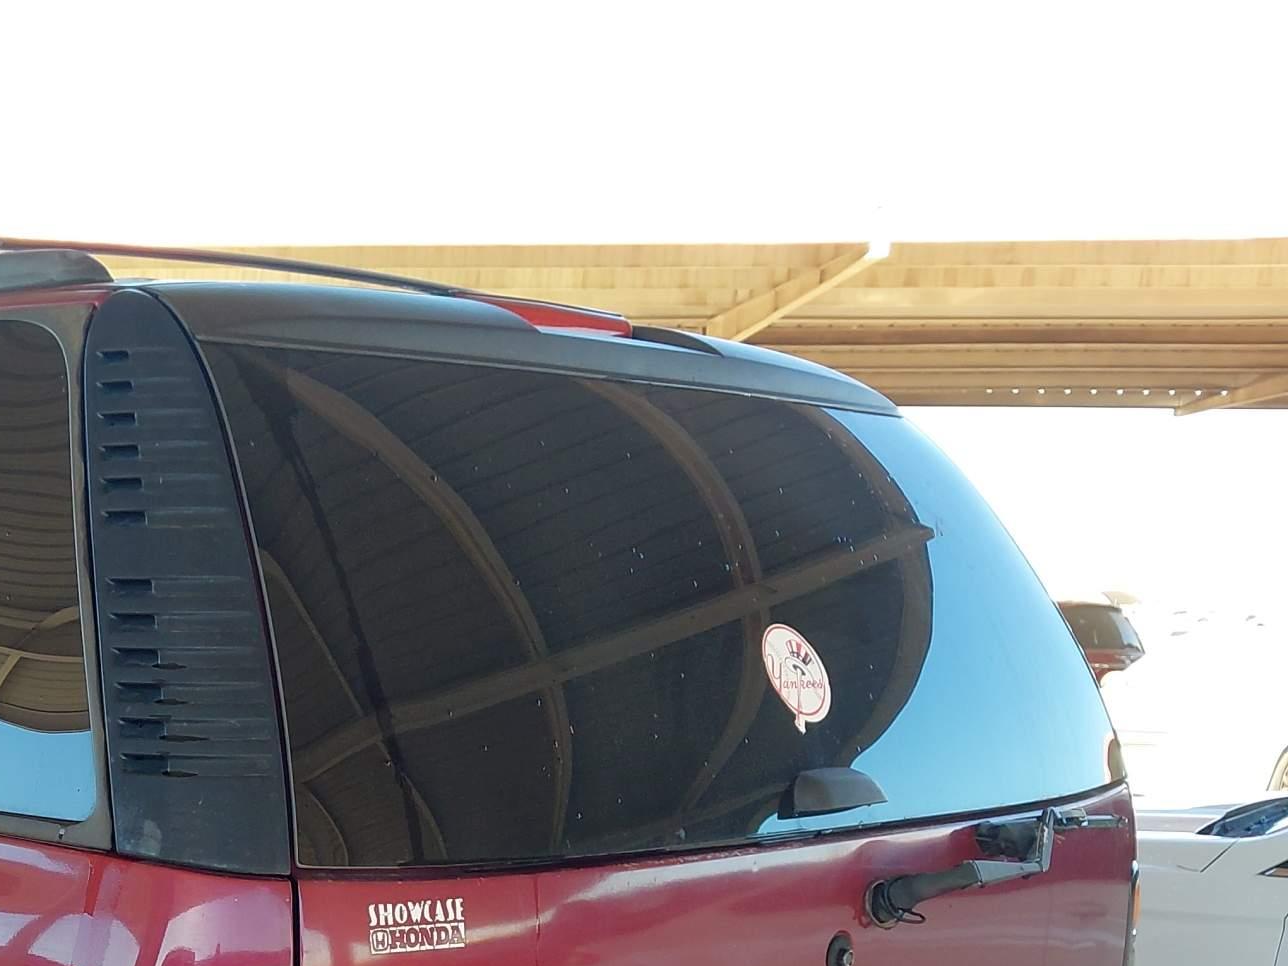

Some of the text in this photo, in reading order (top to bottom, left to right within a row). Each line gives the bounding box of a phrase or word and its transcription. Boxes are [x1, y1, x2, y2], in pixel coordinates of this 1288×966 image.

[765, 653, 823, 693] Yankees
[368, 898, 464, 927] SHOWCASE
[390, 925, 464, 949] HONDA
